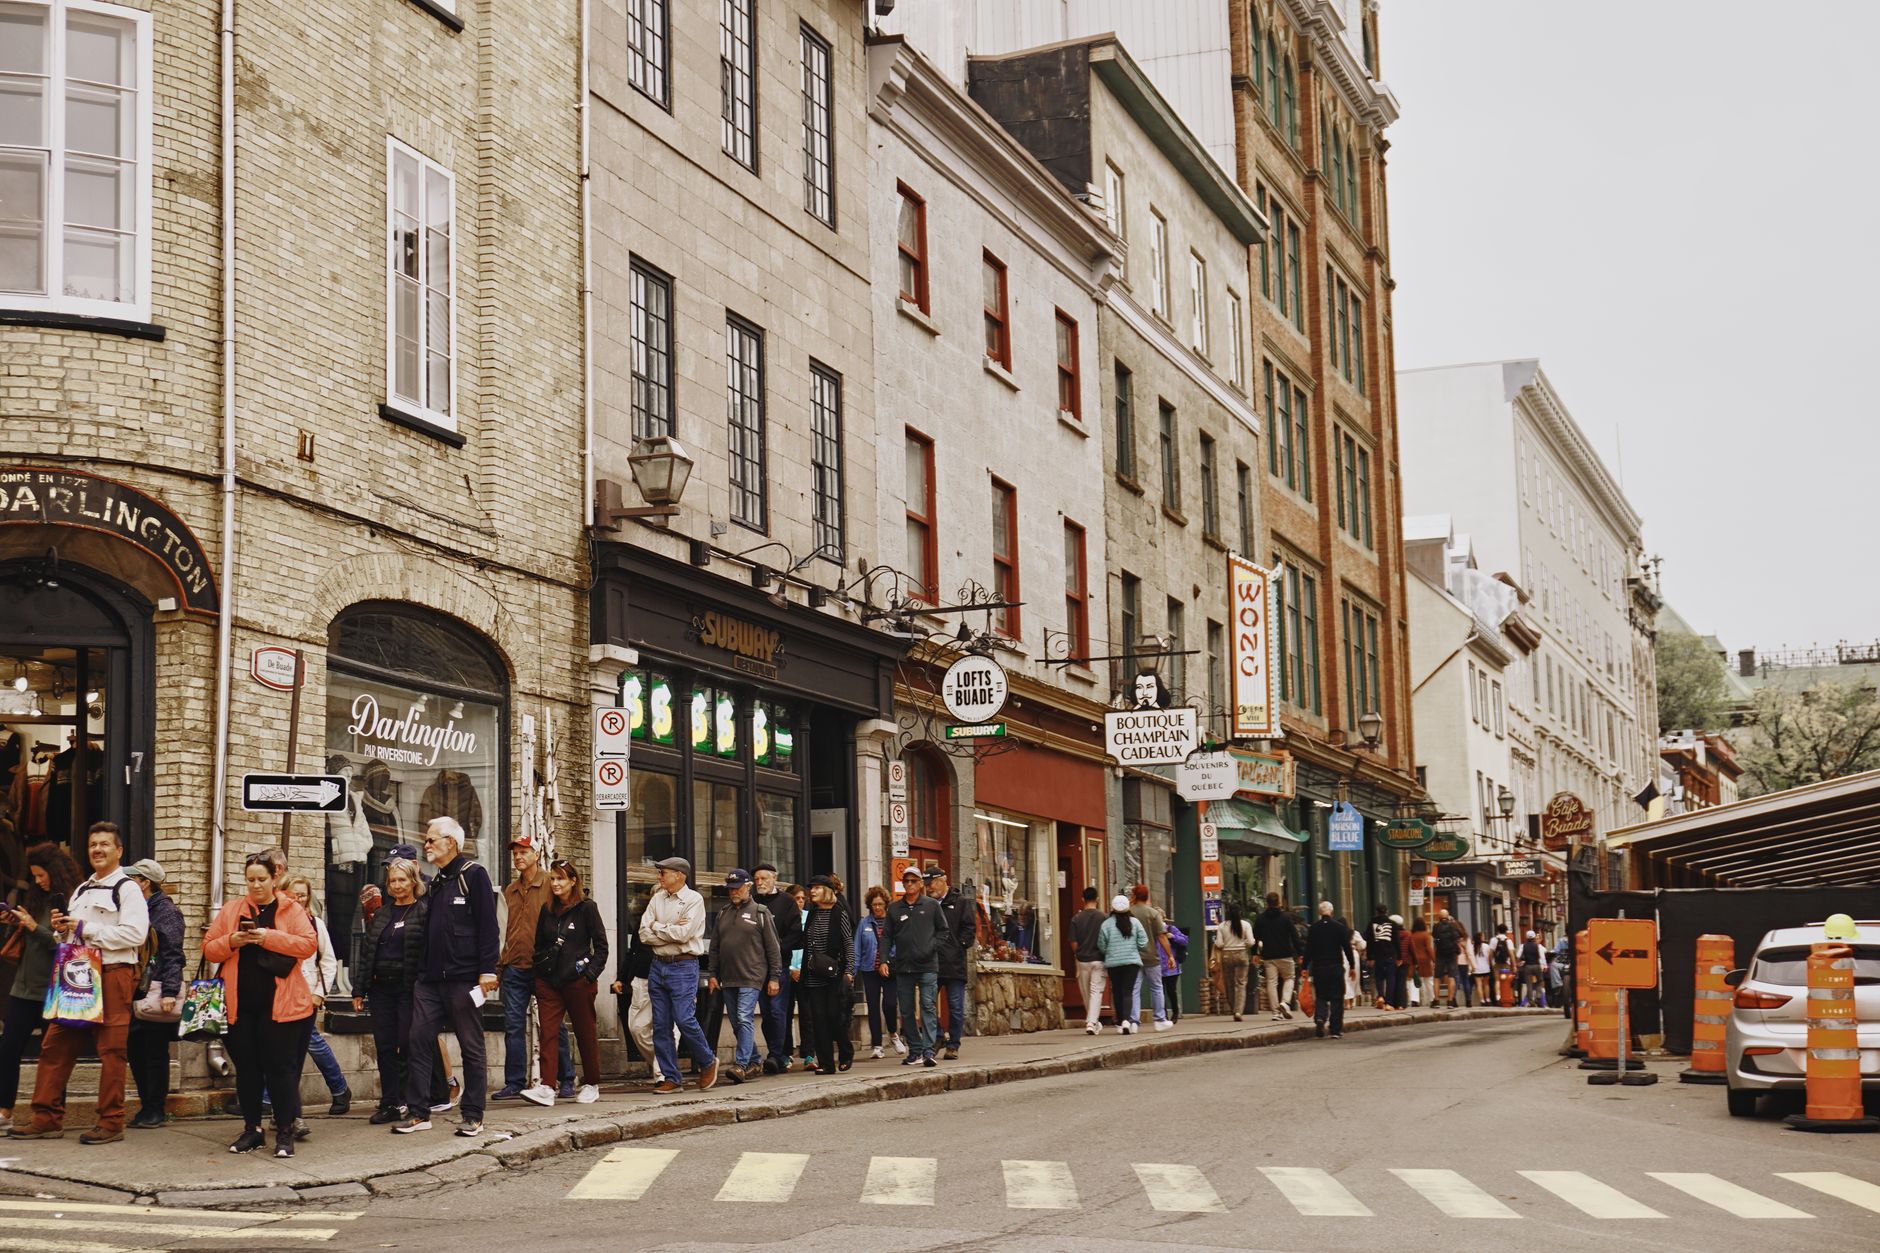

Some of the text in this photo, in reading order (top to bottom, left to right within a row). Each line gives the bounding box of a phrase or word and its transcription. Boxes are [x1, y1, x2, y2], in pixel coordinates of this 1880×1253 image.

[0, 472, 31, 483] ONDÉ
[38, 474, 54, 483] EN
[701, 610, 780, 662] SUBWAY
[1238, 583, 1261, 676] WONG
[957, 670, 991, 688] LOFTS
[955, 688, 994, 706] BUADE
[347, 693, 478, 766] Darlington
[1116, 714, 1185, 730] BOUTIQUE
[951, 725, 1000, 737] SUBWAY
[1113, 729, 1190, 745] CHAMPLAIN
[364, 743, 423, 765] PAR RIVERSTONE
[1121, 745, 1183, 760] CADEAUX
[1184, 761, 1229, 771] SOUVENIRS
[1552, 800, 1579, 821] Café
[1545, 816, 1591, 838] Buade
[1331, 831, 1361, 842] BLEUE
[1505, 861, 1528, 869] DANS
